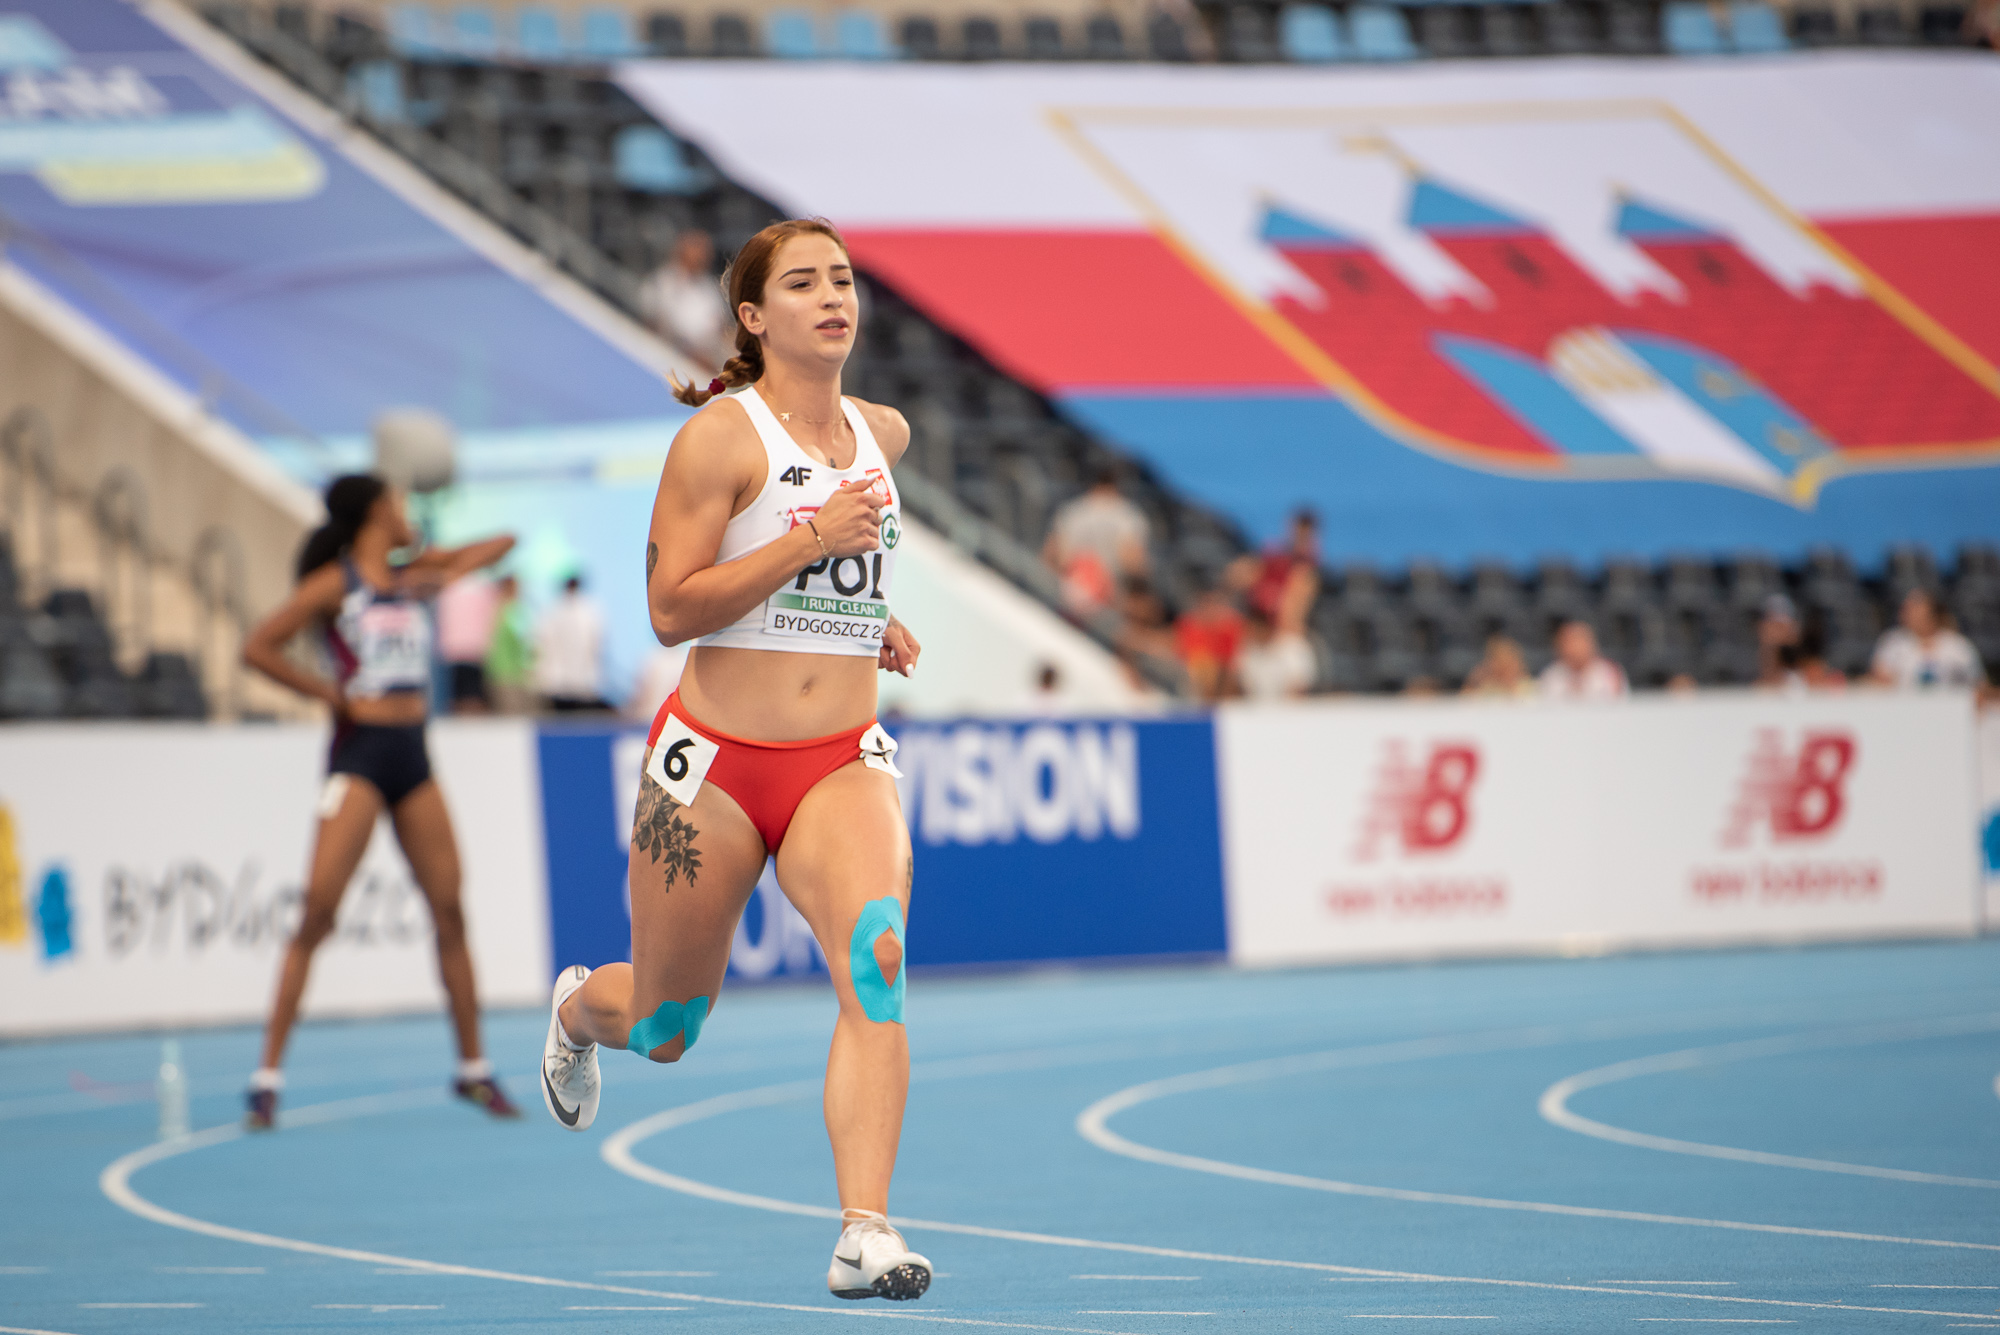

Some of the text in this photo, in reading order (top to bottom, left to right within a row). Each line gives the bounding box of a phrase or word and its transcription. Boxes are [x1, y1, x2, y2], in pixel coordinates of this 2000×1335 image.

[780, 466, 812, 486] 4F
[802, 597, 807, 609] I
[809, 598, 837, 613] RUN
[774, 614, 883, 640] BYDGOSZCZ 2
[664, 738, 696, 781] 6
